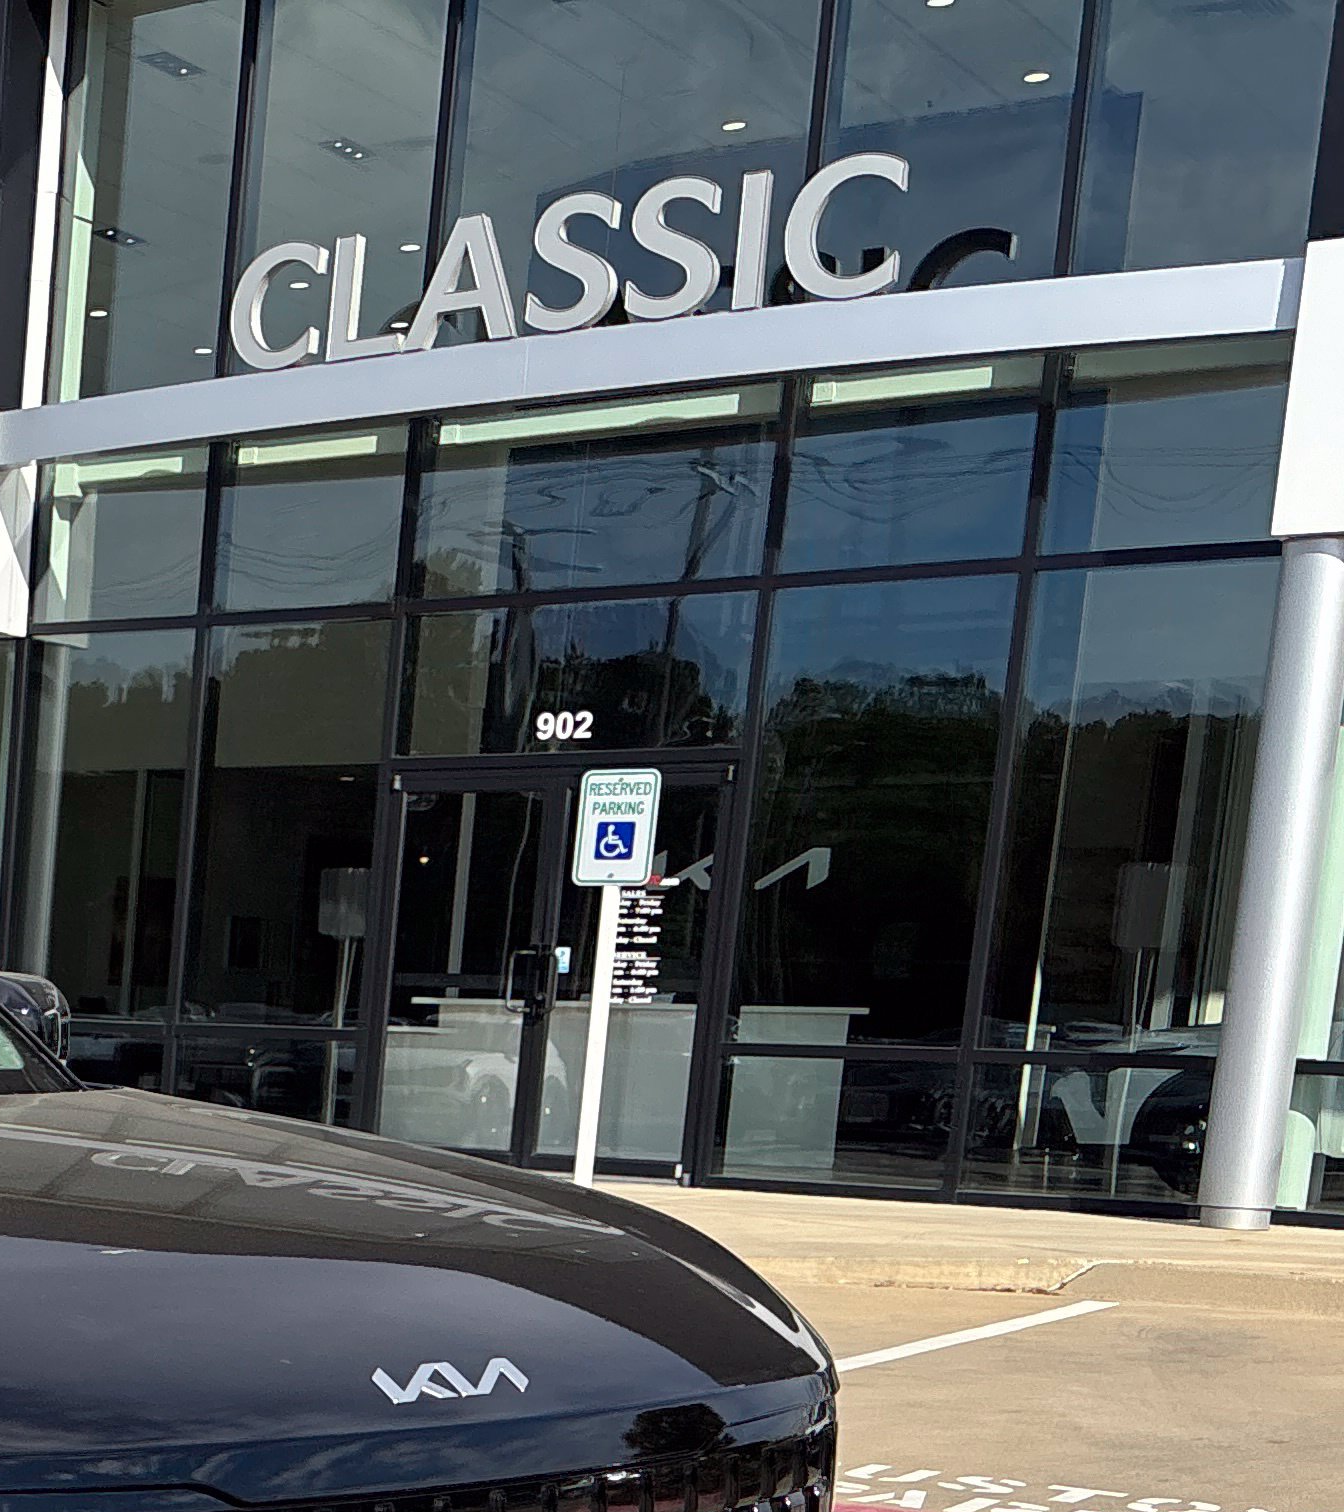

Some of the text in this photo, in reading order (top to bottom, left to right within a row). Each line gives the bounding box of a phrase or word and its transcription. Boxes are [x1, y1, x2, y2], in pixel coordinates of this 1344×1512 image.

[230, 151, 910, 371] CLASSIC
[536, 710, 593, 740] 902
[589, 781, 652, 796] RESERVED
[592, 801, 645, 815] PARKING
[371, 1356, 529, 1404] KIA
